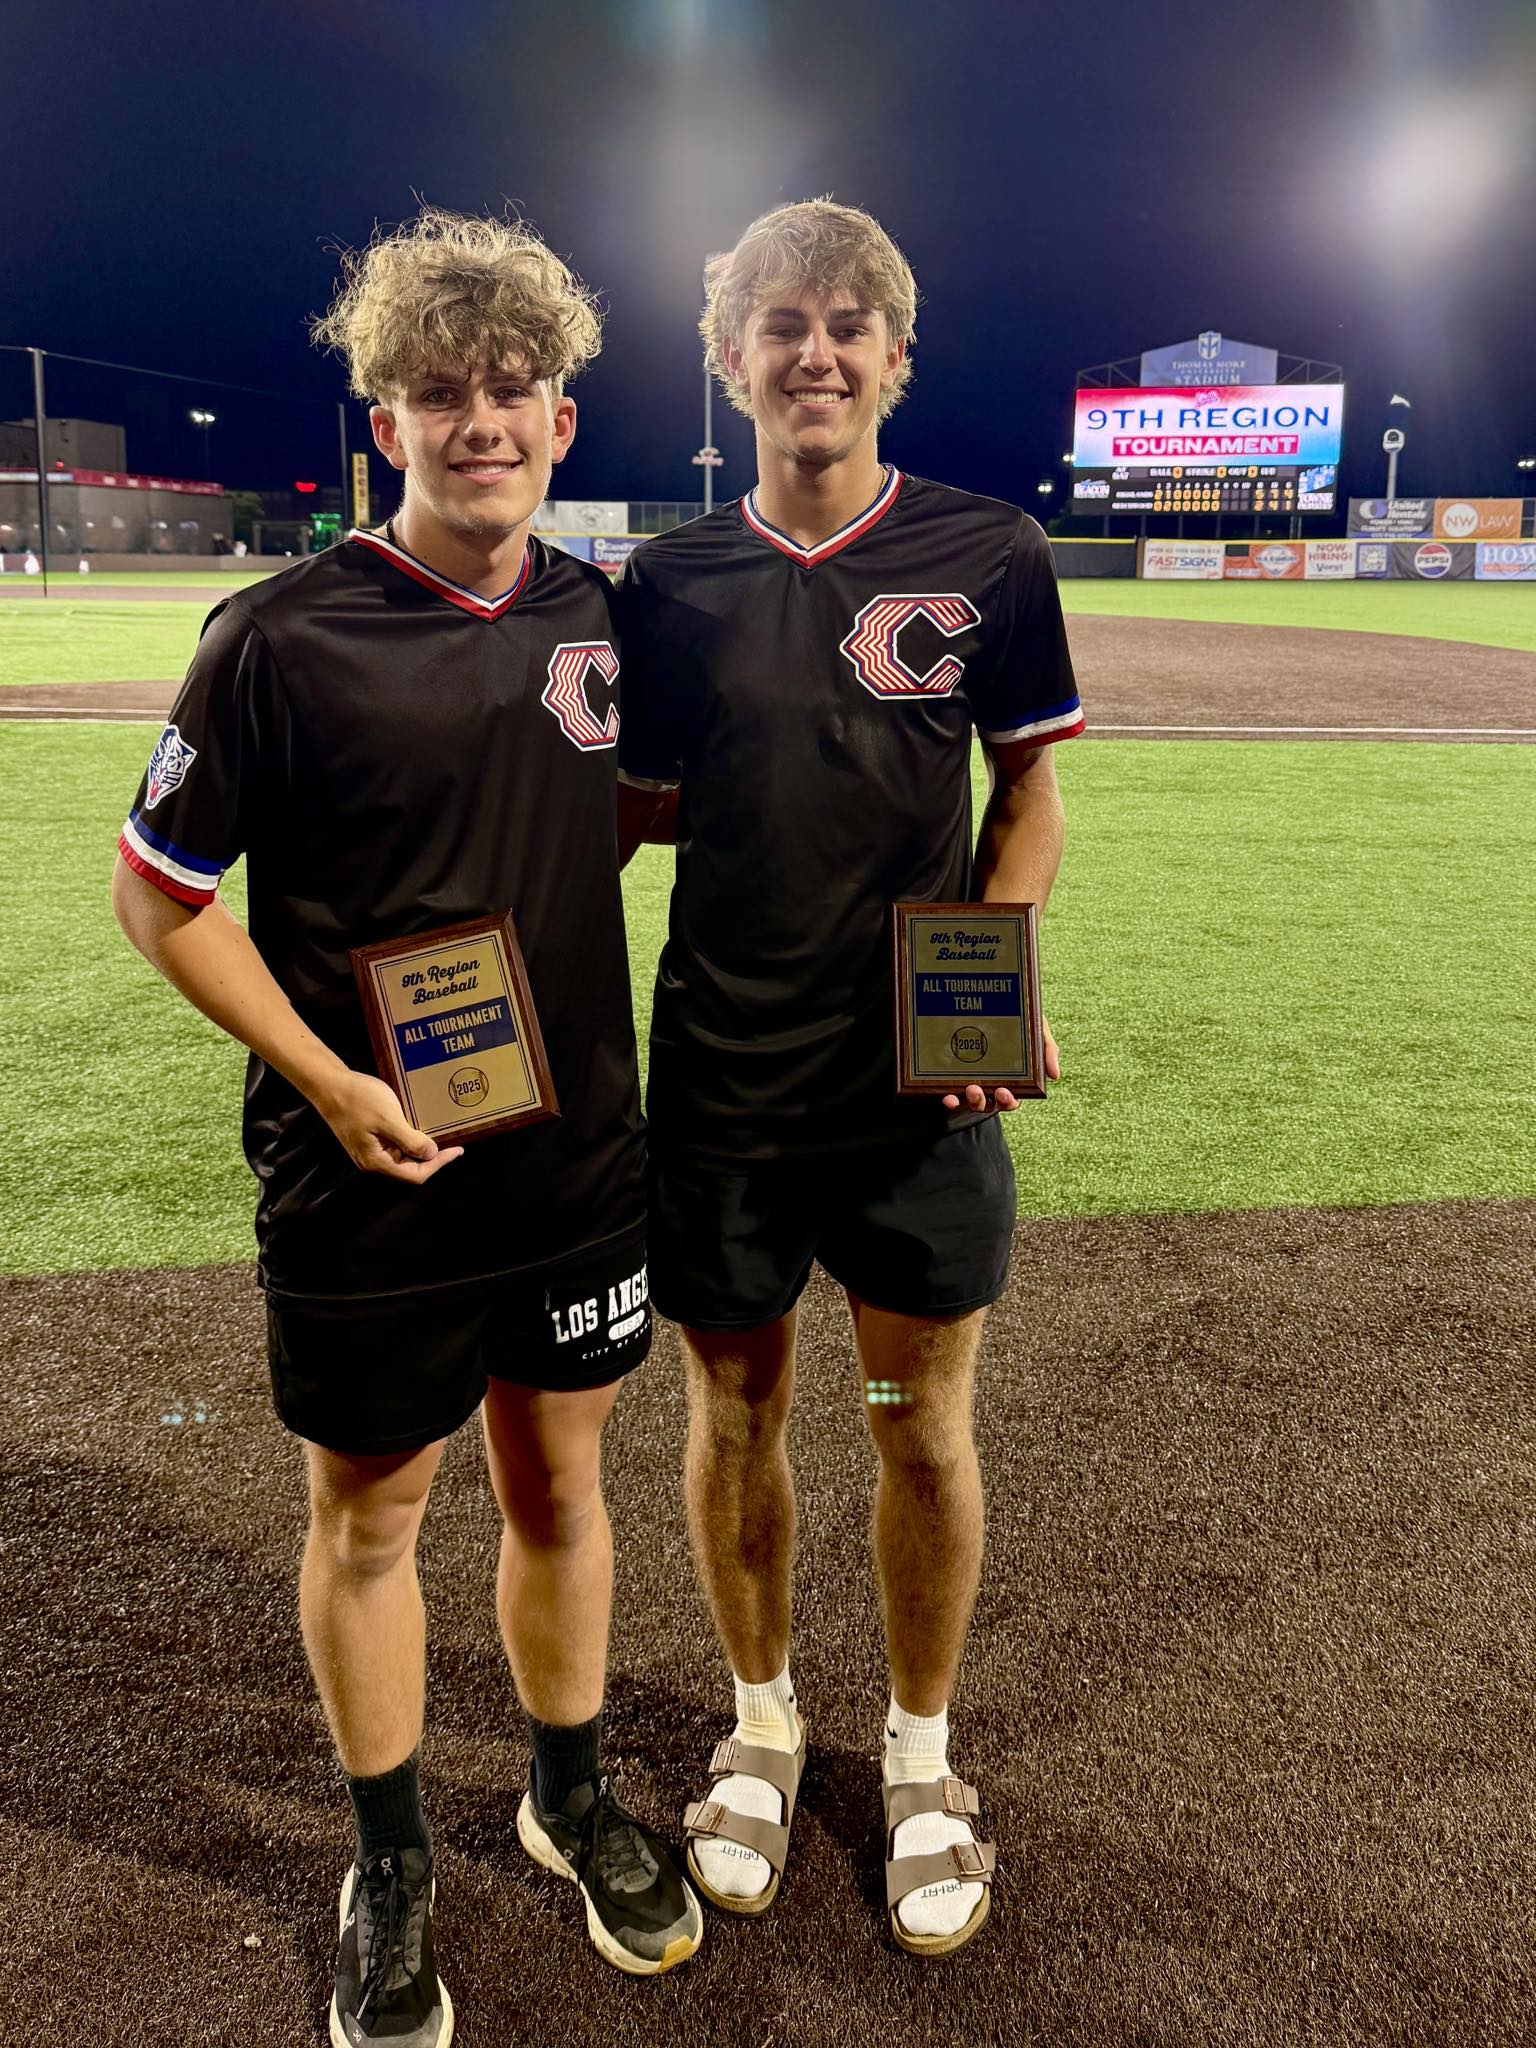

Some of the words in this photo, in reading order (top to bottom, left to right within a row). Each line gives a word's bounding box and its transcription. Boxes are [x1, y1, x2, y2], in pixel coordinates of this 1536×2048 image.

[1172, 360, 1213, 369] THOMAS
[1216, 360, 1247, 368] MORE
[1174, 375, 1241, 385] STADIUM
[1087, 408, 1163, 430] 9TH
[1178, 406, 1330, 429] REGION
[1114, 436, 1297, 456] TOURNAMENT
[1388, 501, 1424, 511] United
[1445, 515, 1475, 528] NW
[1480, 514, 1514, 528] LAW
[1316, 543, 1346, 551] NOW
[1147, 555, 1218, 567] FASTSIGNS
[1308, 552, 1353, 561] HIRING!
[1417, 555, 1450, 564] PEPSI
[839, 593, 981, 700] C
[541, 640, 620, 752] C
[930, 932, 952, 943] 9th
[953, 930, 1002, 947] Region
[935, 947, 997, 961] Baseball
[402, 971, 427, 988] 9th
[427, 959, 481, 984] Region
[412, 976, 479, 1005] Baseball
[923, 979, 942, 992] ALL
[944, 979, 1013, 992] TOURNAMENT
[953, 996, 983, 1010] TEAM
[405, 1026, 427, 1044] ALL
[427, 1004, 503, 1038] TOURNAMENT
[442, 1032, 476, 1054] TEAM
[958, 1039, 981, 1050] 2025
[456, 1078, 481, 1096] 2025
[551, 1297, 599, 1344] LOS
[607, 1263, 649, 1322] ANGE
[582, 1347, 609, 1360] CITY
[616, 1338, 629, 1348] OF
[721, 1843, 760, 1860] DRI-FIT
[919, 1880, 963, 1899] DRI-FIT
